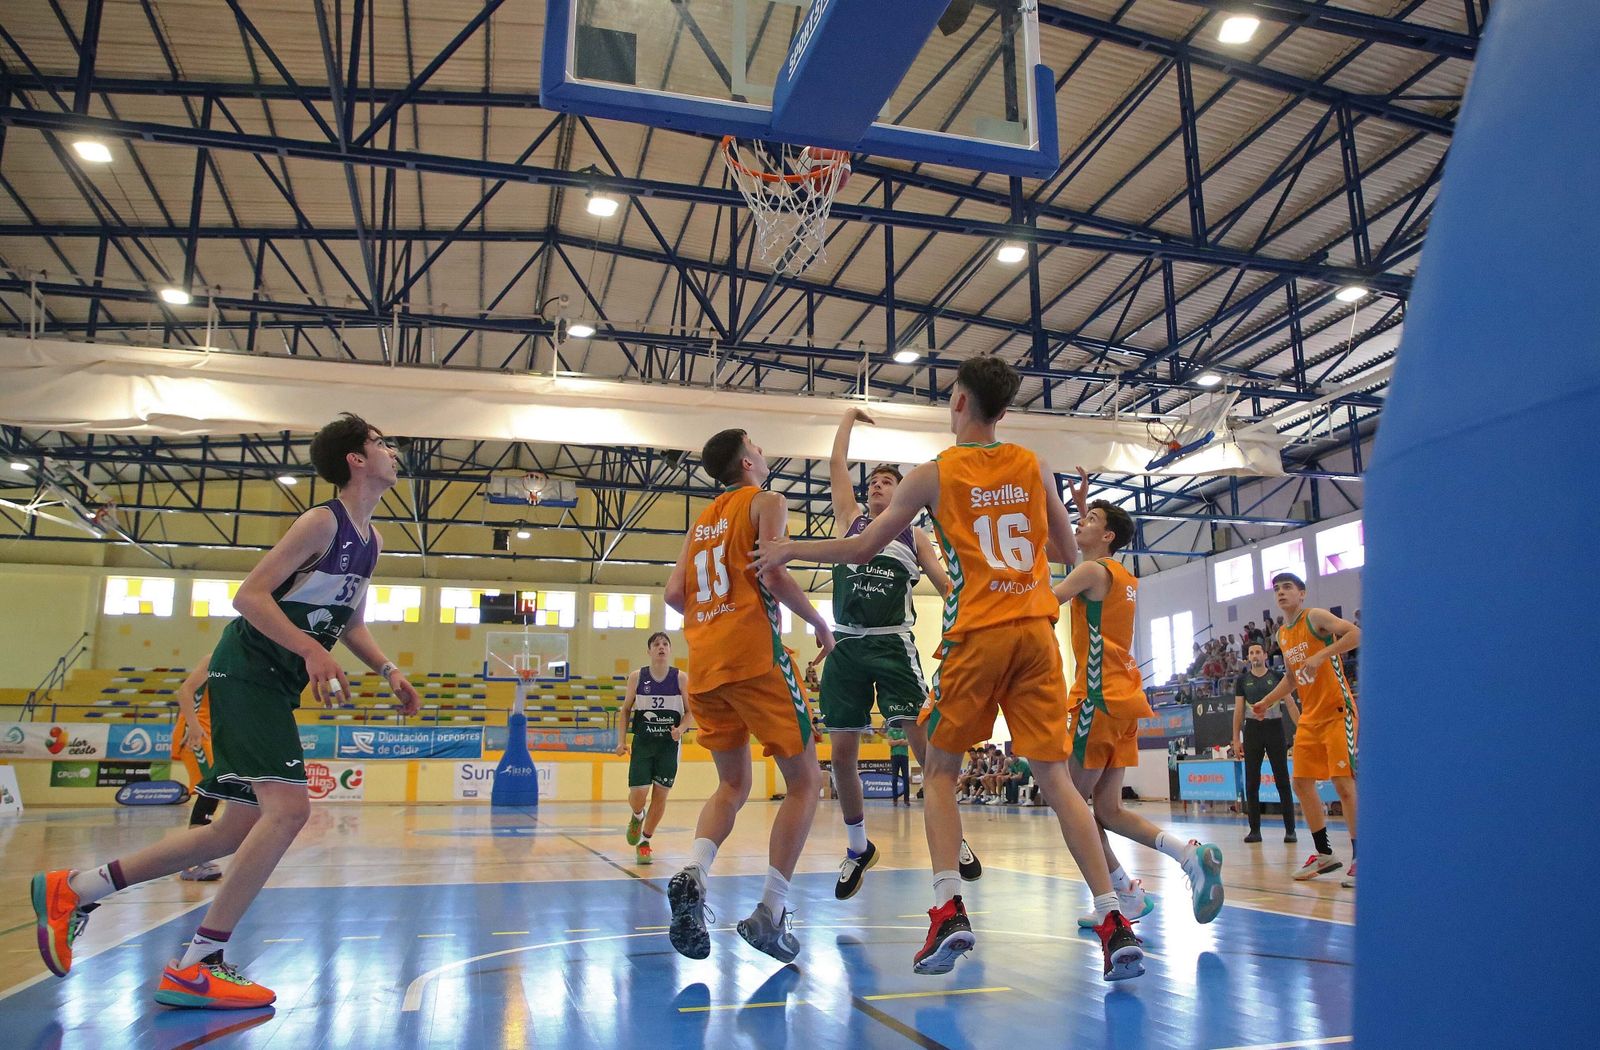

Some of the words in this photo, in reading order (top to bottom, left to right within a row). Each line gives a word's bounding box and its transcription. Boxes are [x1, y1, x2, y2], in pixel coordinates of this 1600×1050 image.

[973, 513, 1036, 574] 16
[694, 541, 730, 604] 15
[866, 566, 895, 578] Unicaja
[335, 576, 362, 602] 35
[521, 599, 536, 612] 14
[651, 697, 665, 708] 32
[378, 731, 429, 743] Diputación
[437, 732, 480, 741] DEPORTES
[378, 745, 390, 755] de
[393, 744, 420, 755] Cádiz
[1187, 774, 1224, 785] deportes
